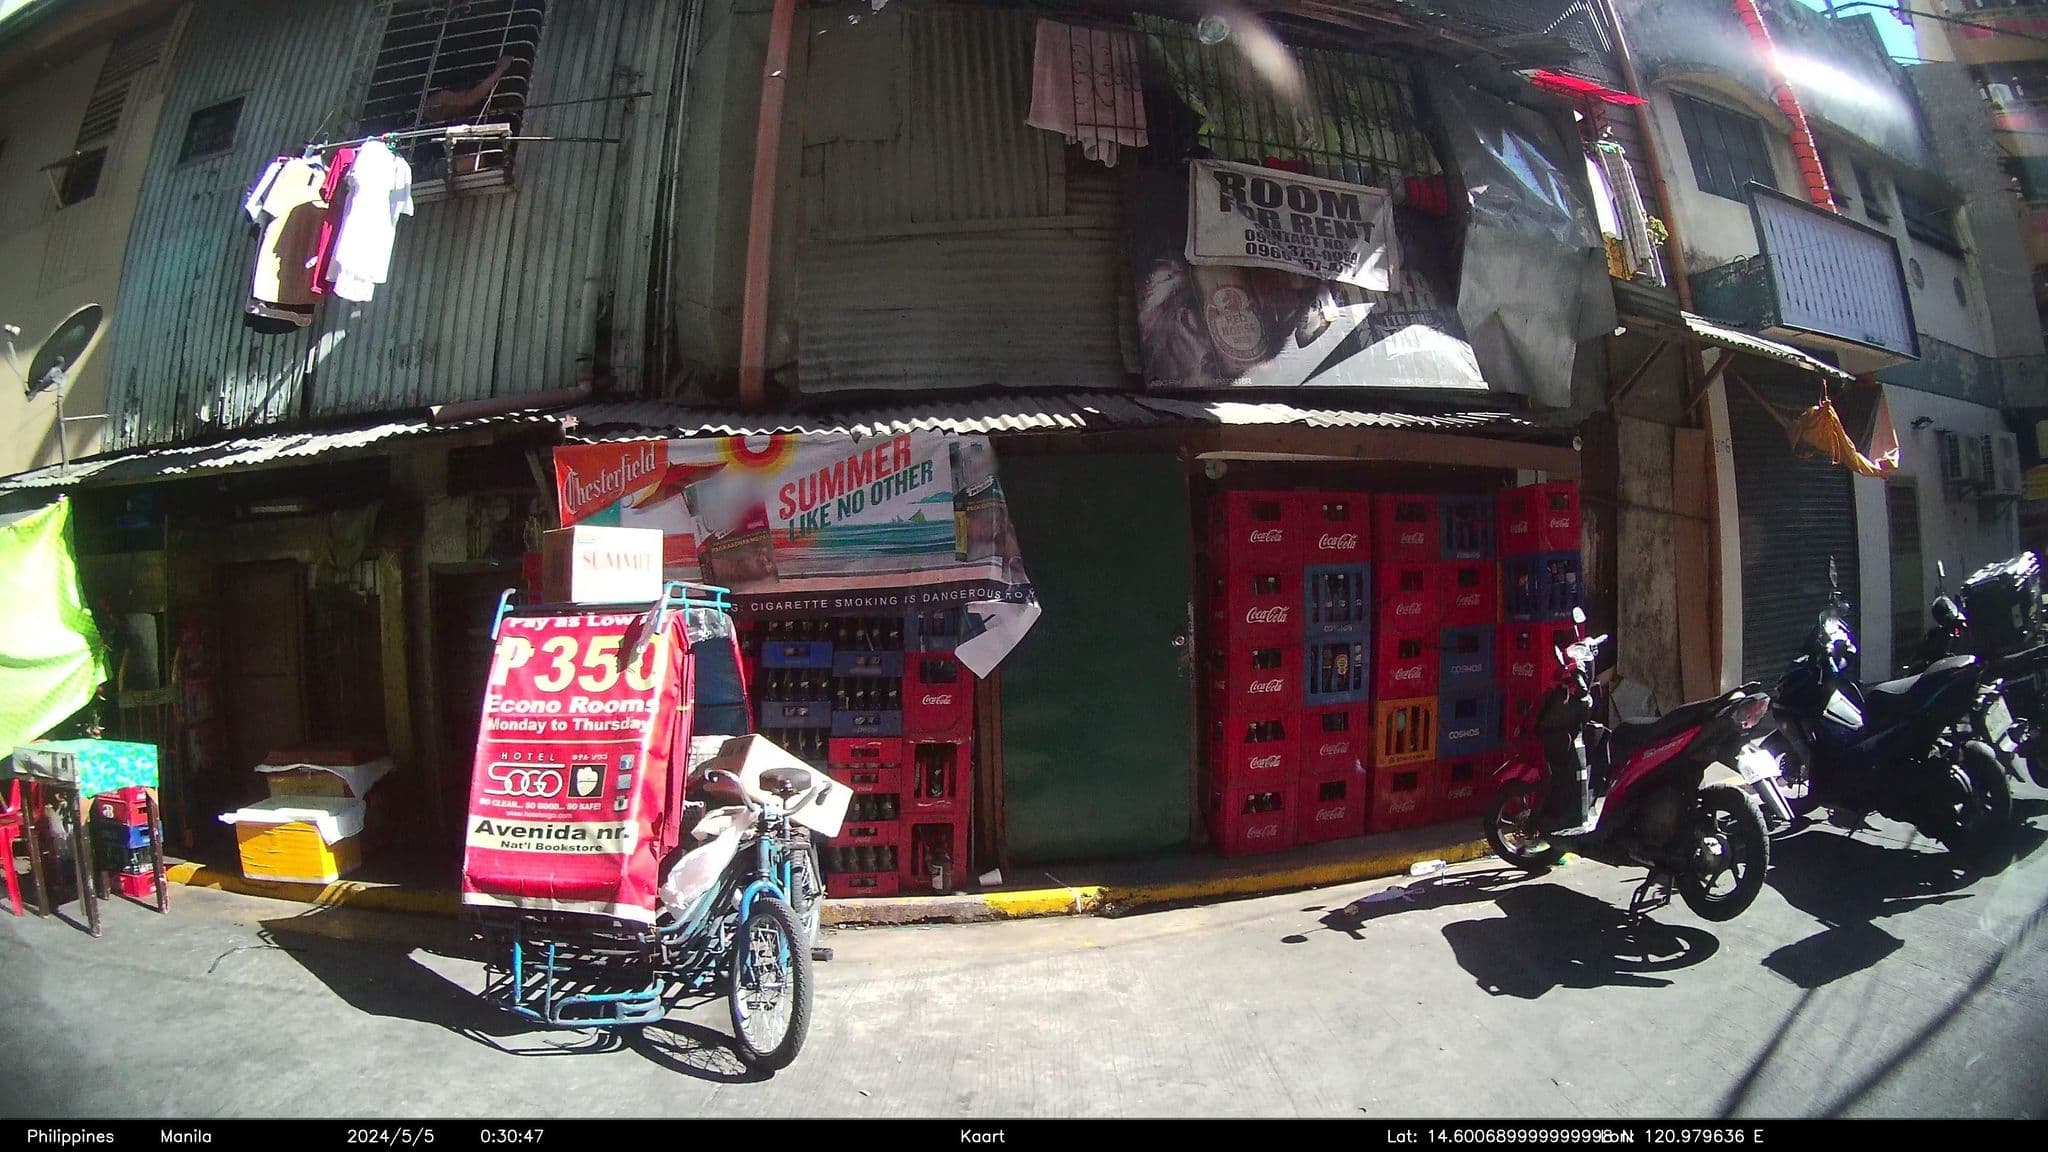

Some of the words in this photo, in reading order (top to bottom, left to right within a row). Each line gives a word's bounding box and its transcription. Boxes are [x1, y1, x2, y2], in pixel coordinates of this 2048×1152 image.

[1213, 171, 1362, 221] ROOM
[1219, 195, 1282, 230] FOR
[1290, 213, 1376, 244] RENT
[564, 441, 657, 515] Chesterfield
[778, 434, 913, 520] SUMMER
[788, 503, 831, 542] LIKE
[837, 491, 865, 522] NO
[870, 459, 934, 506] OTHER
[582, 551, 653, 571] SUMMIT
[750, 599, 829, 612] CIGARETTE
[835, 596, 898, 609] SMOKING
[904, 594, 917, 604] IS
[923, 587, 1001, 603] DANGEROUS
[587, 613, 635, 629] Low
[486, 694, 562, 714] Econo
[569, 696, 660, 714] Rooms
[487, 717, 546, 734] Monday
[551, 718, 568, 732] to
[573, 717, 651, 734] Thursday
[501, 752, 556, 761] HOTEL
[483, 761, 566, 798] SOGO
[475, 820, 587, 840] Avenida
[597, 826, 630, 840] nr.
[501, 840, 531, 850] Nat'l
[536, 842, 603, 852] Bookstore
